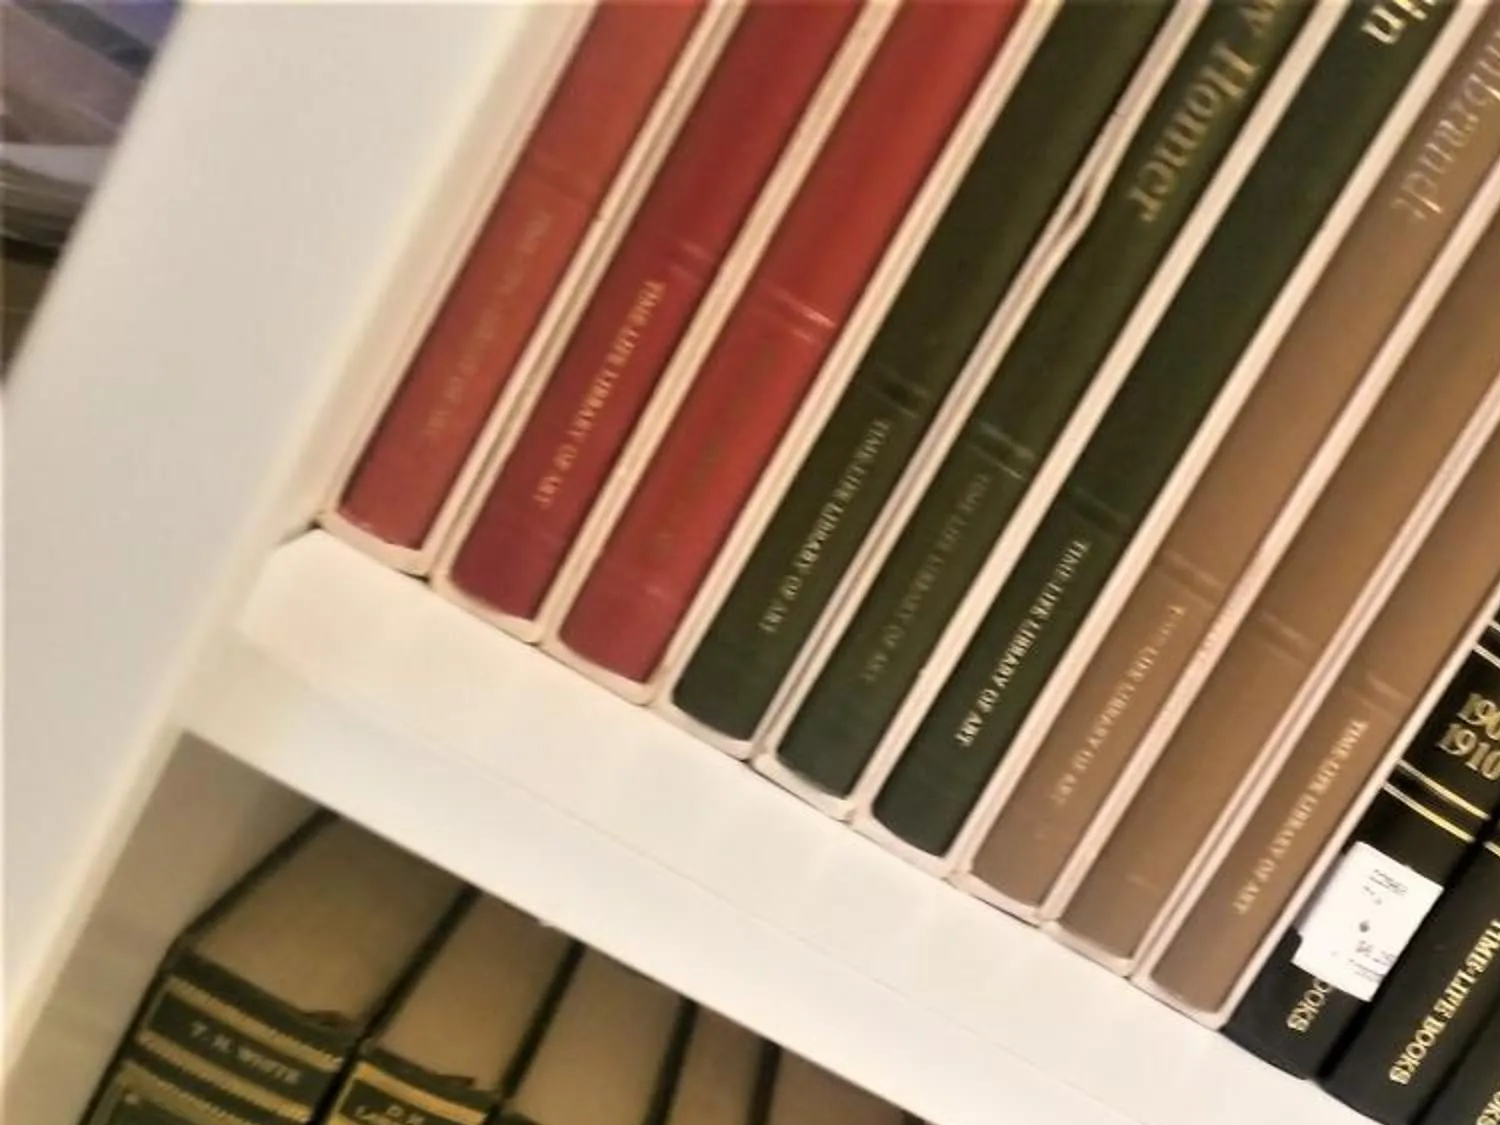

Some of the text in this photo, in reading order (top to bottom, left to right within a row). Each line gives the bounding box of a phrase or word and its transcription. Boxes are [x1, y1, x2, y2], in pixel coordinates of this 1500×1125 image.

[1129, 44, 1261, 224] Homer
[565, 364, 618, 443] LIBRARY
[548, 439, 577, 472] OF
[529, 469, 564, 510] ART
[987, 616, 1041, 688] LIBRARY
[971, 685, 999, 715] OF
[951, 708, 986, 749] ART
[1264, 790, 1320, 860] LIBRARY
[1249, 855, 1278, 885] OF
[1227, 877, 1263, 916] ART
[234, 1044, 303, 1088] WHITE
[1385, 1014, 1446, 1088] BOOKS
